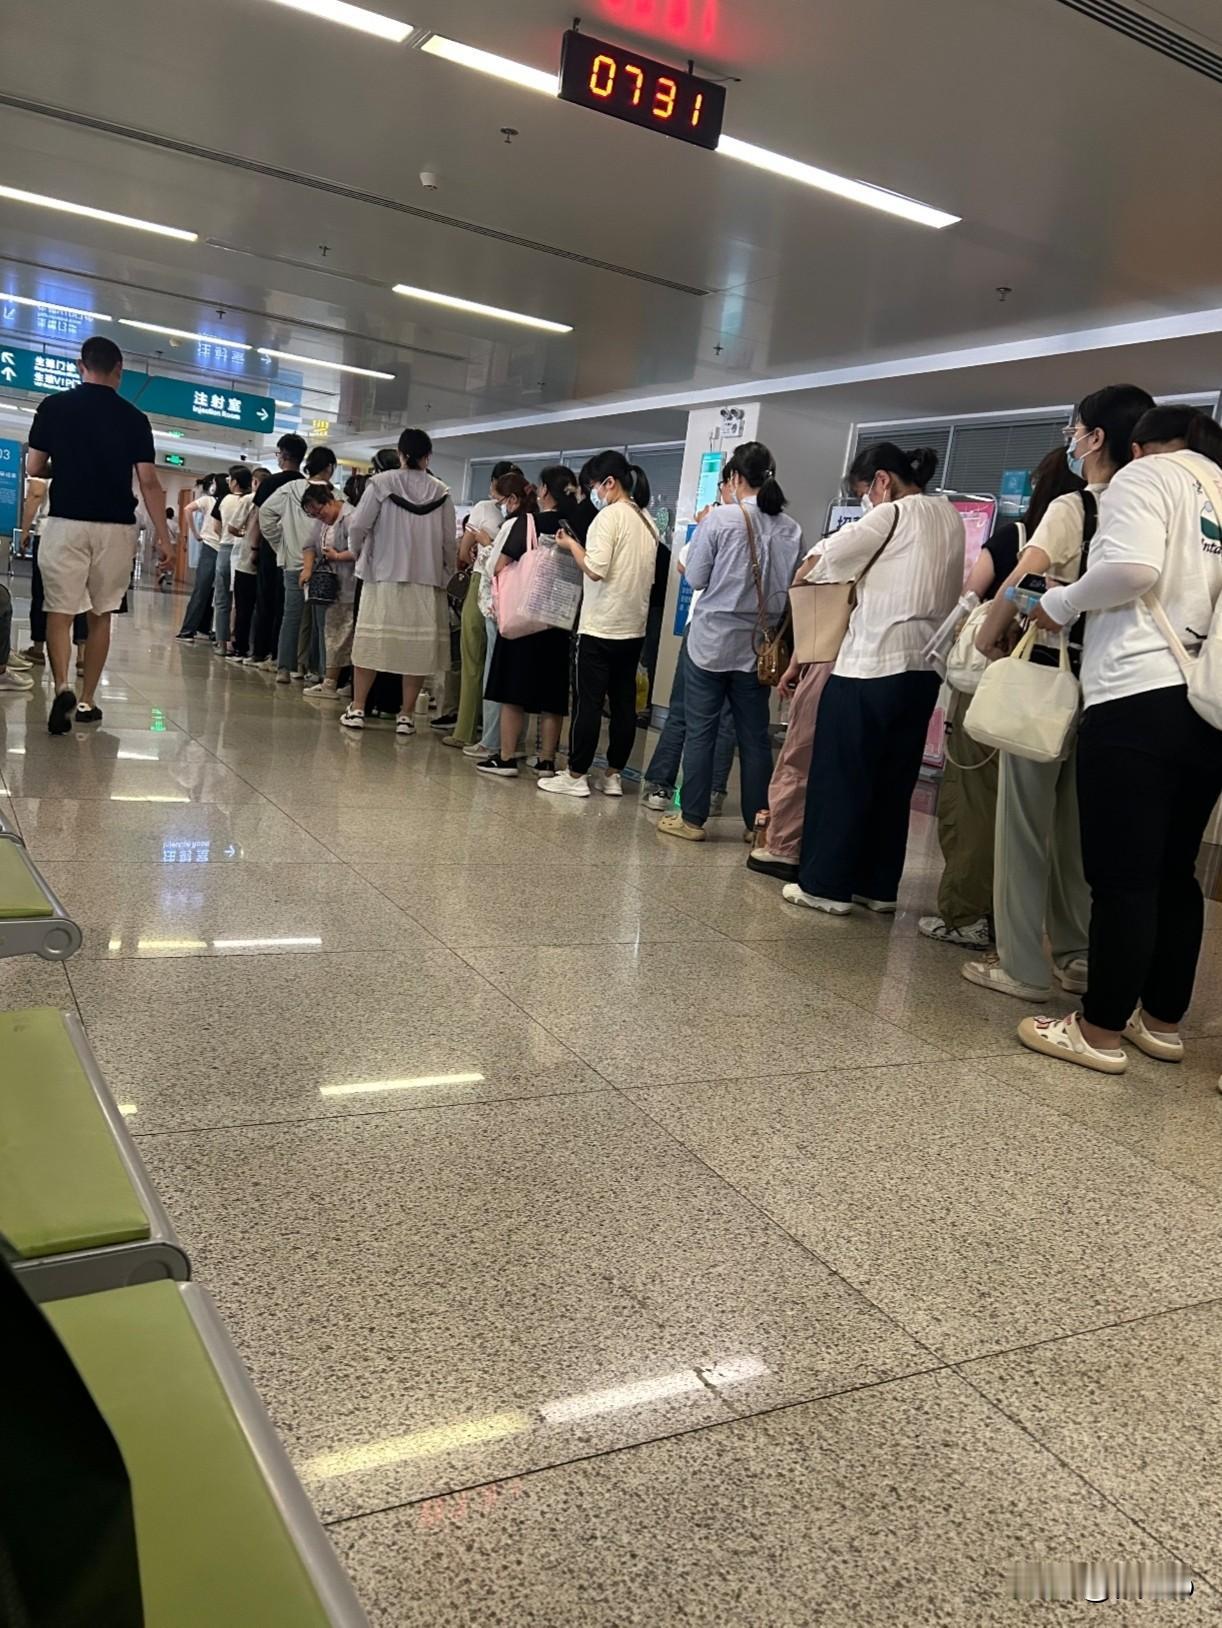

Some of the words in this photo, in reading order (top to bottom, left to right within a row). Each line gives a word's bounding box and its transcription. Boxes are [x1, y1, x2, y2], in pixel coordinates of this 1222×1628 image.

[590, 54, 702, 126] 0731
[193, 391, 242, 413] 注射室
